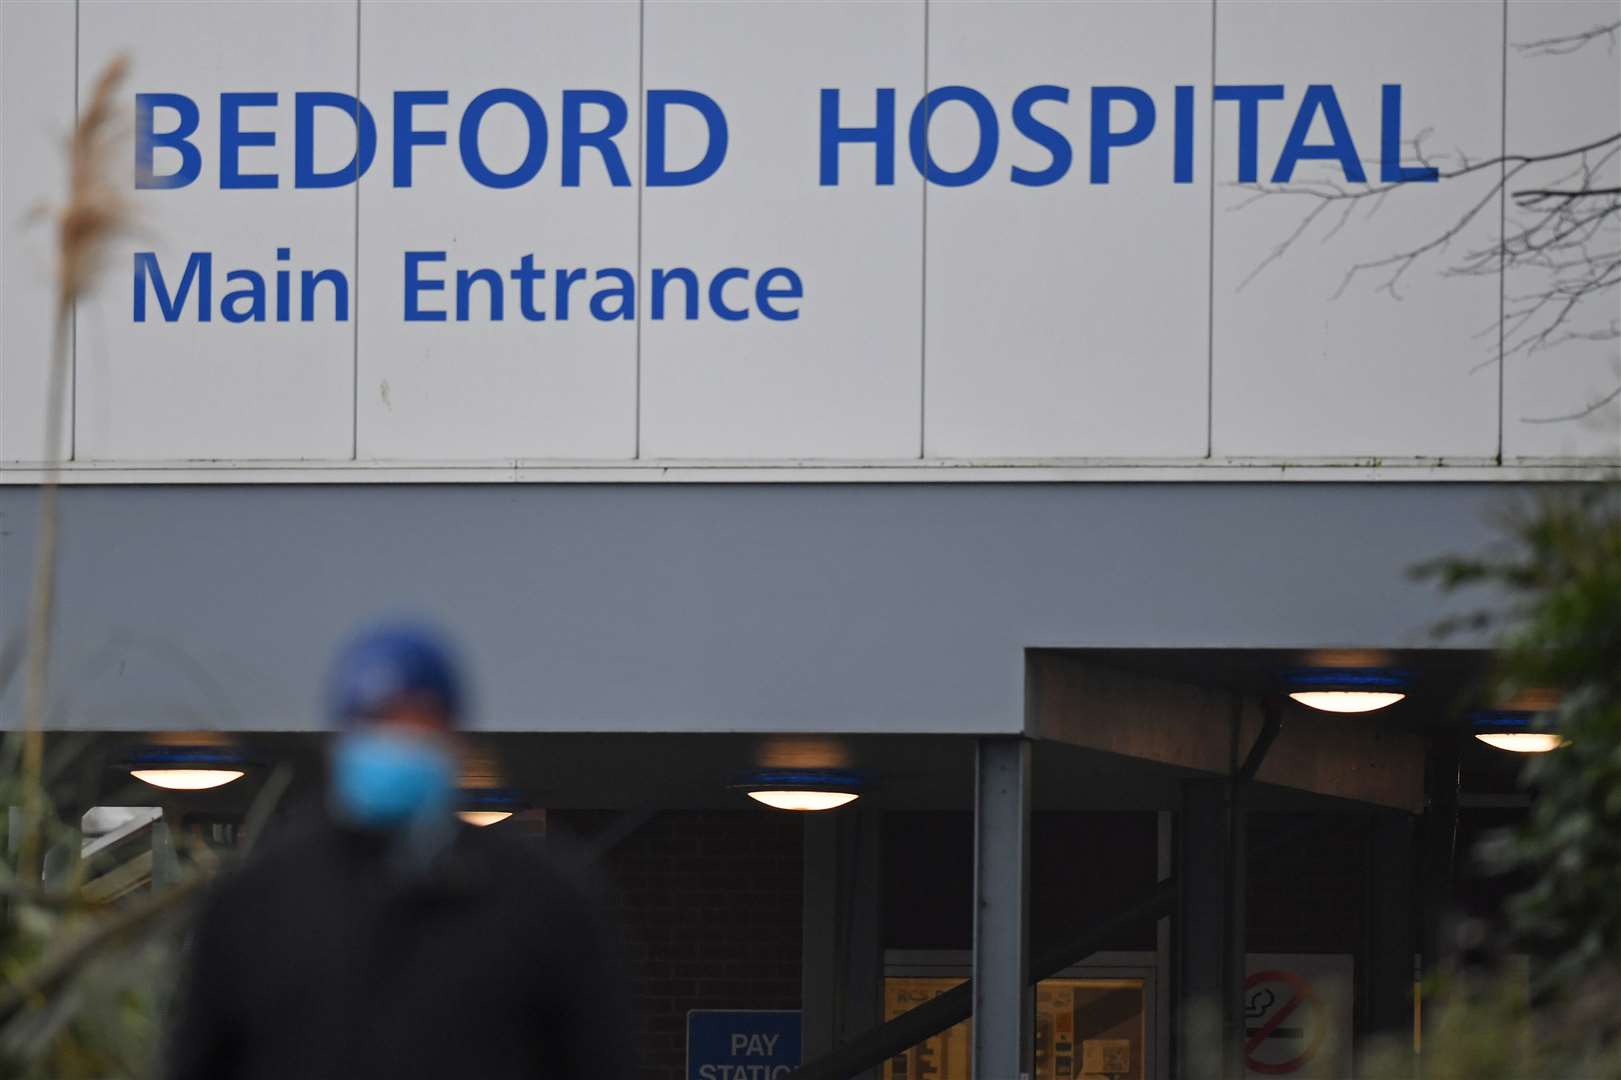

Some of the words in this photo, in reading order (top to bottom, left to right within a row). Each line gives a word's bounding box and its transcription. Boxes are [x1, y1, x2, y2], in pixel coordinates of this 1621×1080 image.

[134, 88, 729, 190] BEDFORD
[819, 84, 1440, 187] HOSPITAL
[132, 247, 350, 324] Main
[403, 251, 804, 323] Entrance
[729, 1033, 779, 1056] PAY
[699, 1064, 800, 1080] STATIO
